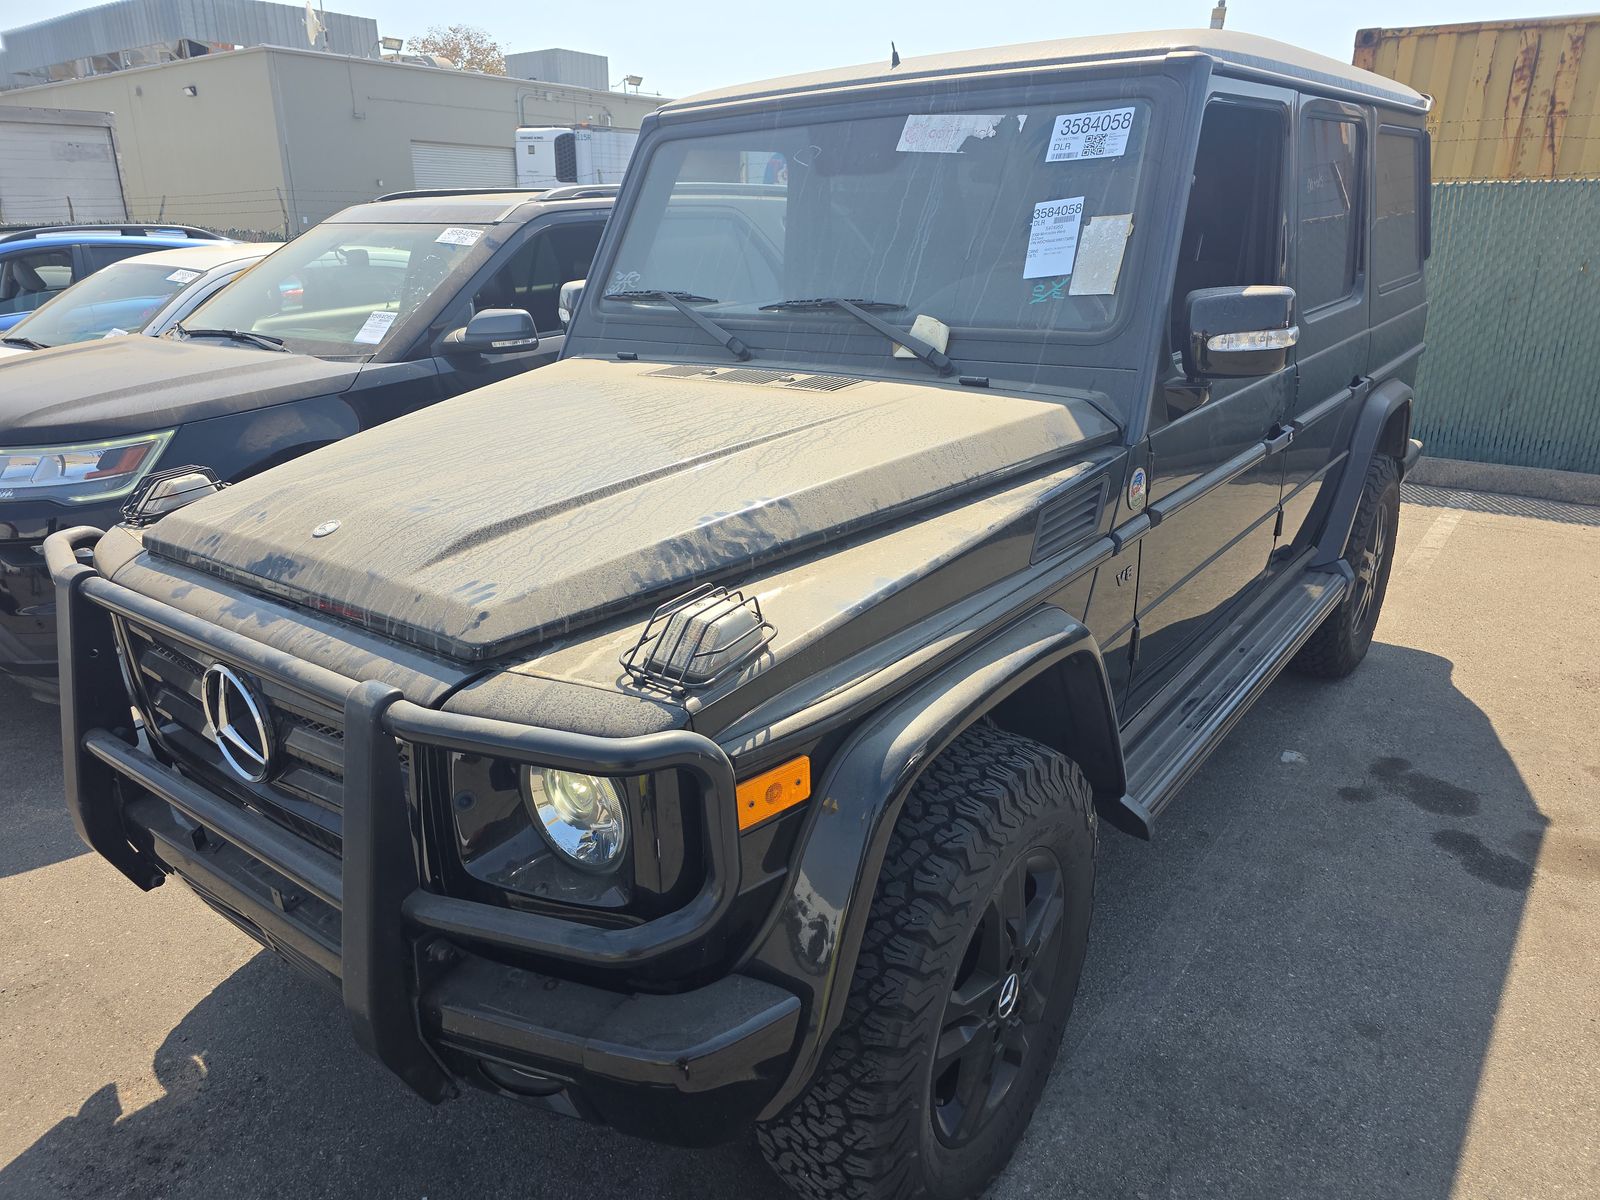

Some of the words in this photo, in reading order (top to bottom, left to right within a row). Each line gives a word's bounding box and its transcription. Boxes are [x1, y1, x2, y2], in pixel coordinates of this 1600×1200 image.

[1060, 112, 1132, 136] 3584058
[1053, 143, 1071, 151] DLR
[1033, 203, 1083, 220] 3584058
